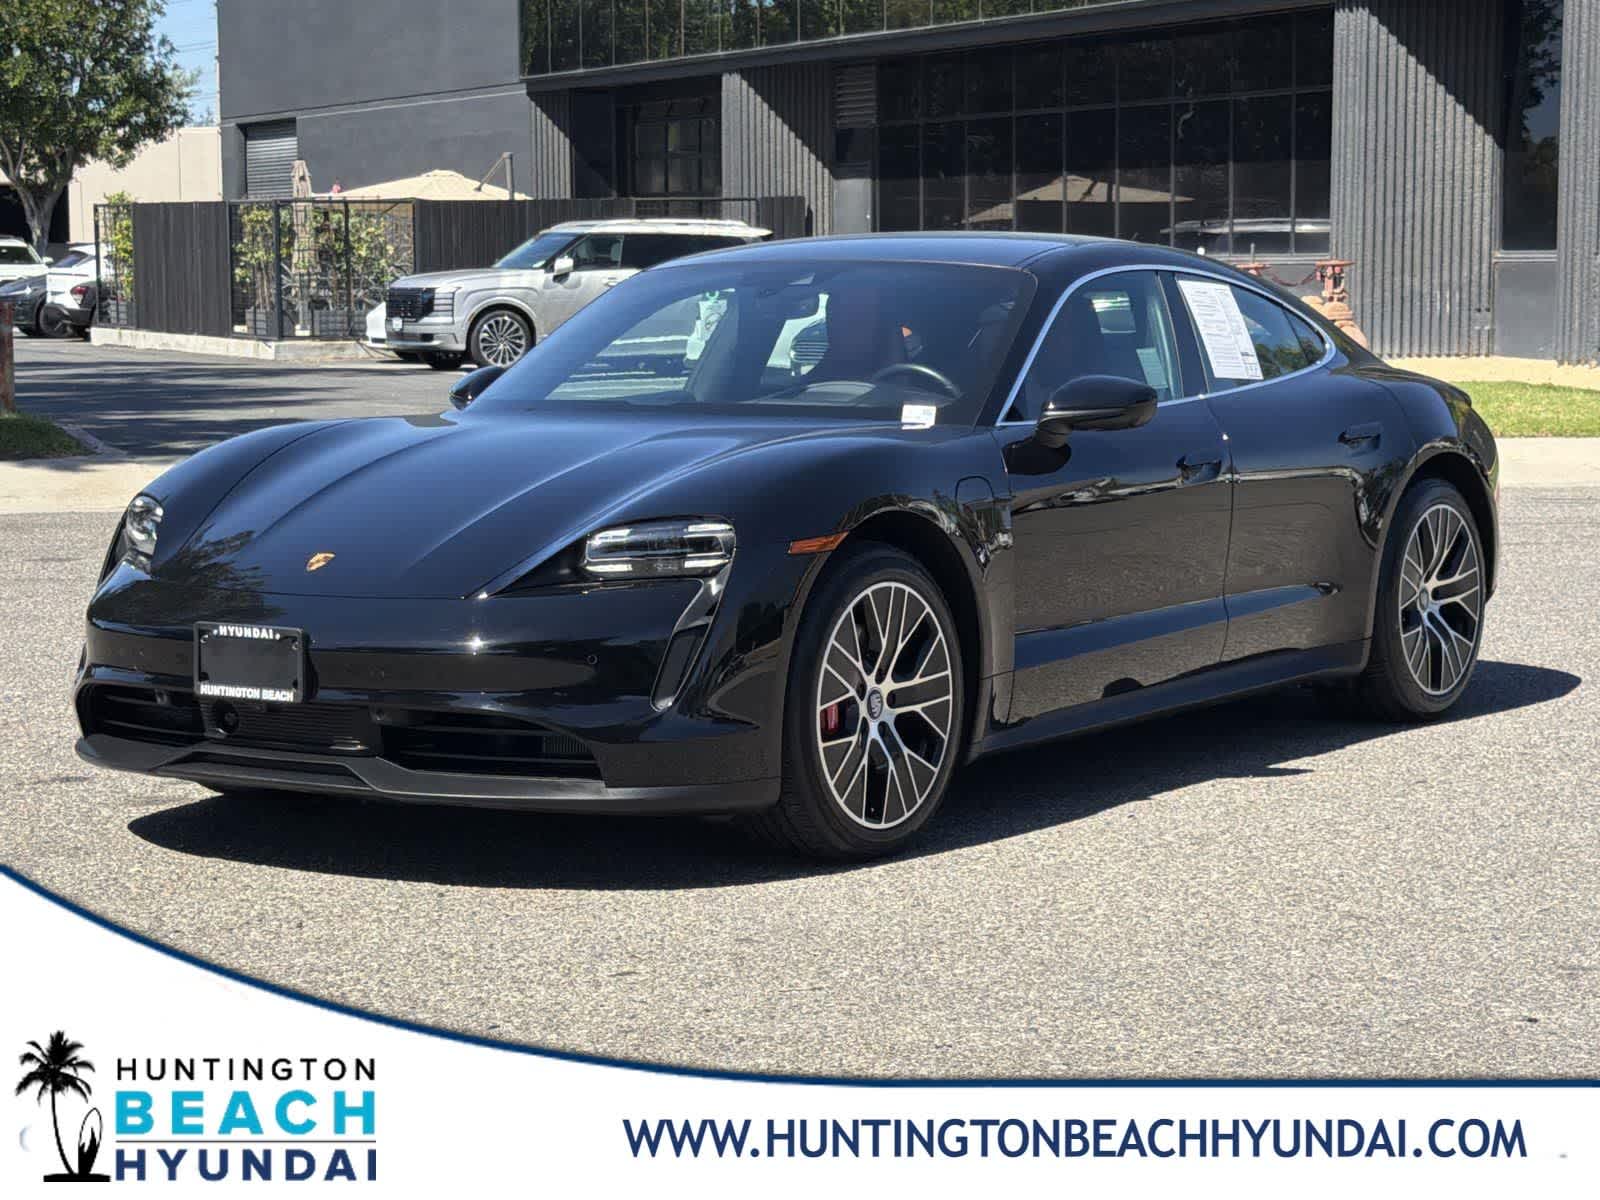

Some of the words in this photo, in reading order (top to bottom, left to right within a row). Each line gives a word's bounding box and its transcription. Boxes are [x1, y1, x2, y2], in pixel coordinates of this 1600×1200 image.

[219, 625, 274, 640] HYUNDAI
[200, 683, 260, 700] HUNTINGTON
[261, 688, 294, 702] BEACH
